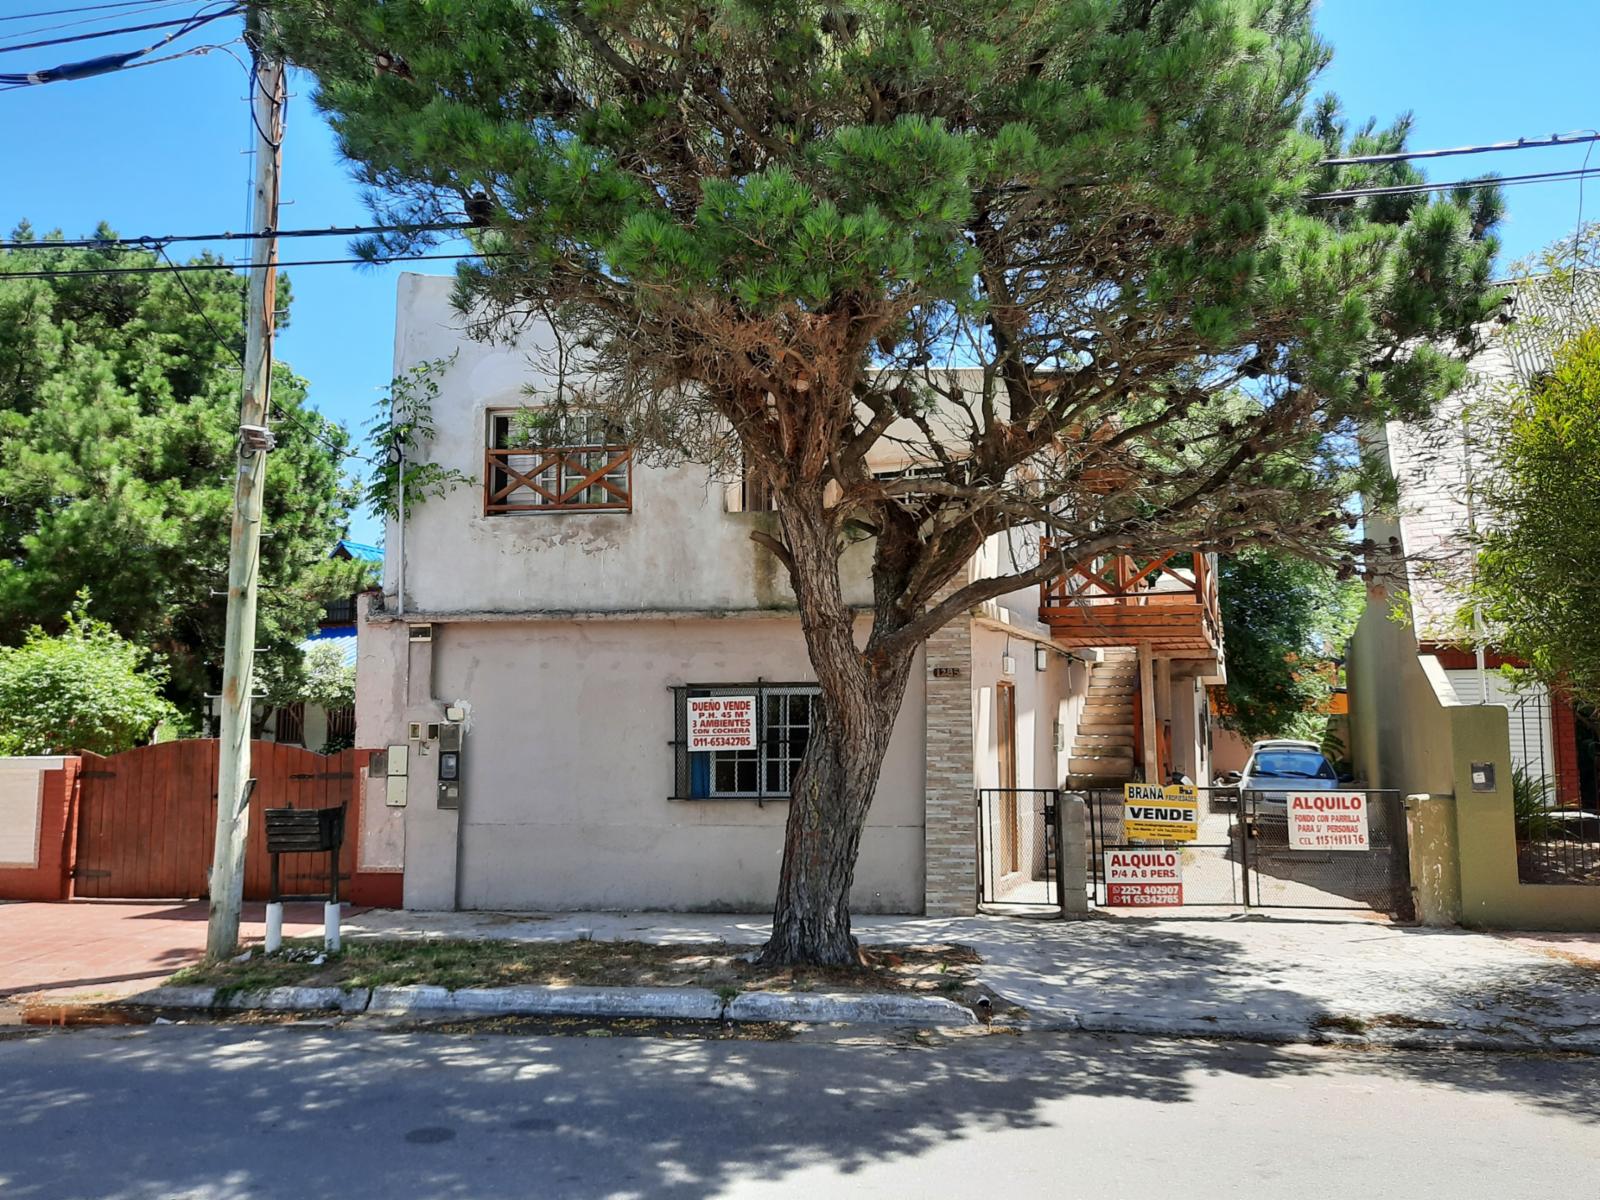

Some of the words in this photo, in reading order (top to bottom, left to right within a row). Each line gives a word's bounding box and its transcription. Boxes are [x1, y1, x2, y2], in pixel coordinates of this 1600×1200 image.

[692, 699, 721, 712] DUEÑO
[723, 700, 751, 710] VENDE
[692, 720, 697, 728] 3
[700, 719, 751, 728] AMBIENTES
[693, 737, 751, 747] 011-65342785
[1128, 785, 1164, 800] BRAÑA
[1292, 797, 1362, 812] ALQUILO
[1129, 807, 1193, 821] VENDE
[1294, 814, 1316, 823] FONDO
[1317, 814, 1330, 823] CON
[1331, 814, 1361, 823] PARRILLA
[1327, 825, 1359, 833] PERSONAS
[1111, 854, 1175, 869] ALQUILO
[1111, 870, 1128, 878] P/4
[1131, 870, 1138, 878] A
[1141, 870, 1147, 878] 8
[1150, 869, 1178, 878] PERS.
[1121, 885, 1142, 895] 2252
[1144, 885, 1179, 895] 402907
[1121, 895, 1131, 904] 11
[1133, 895, 1179, 904] 65342785
